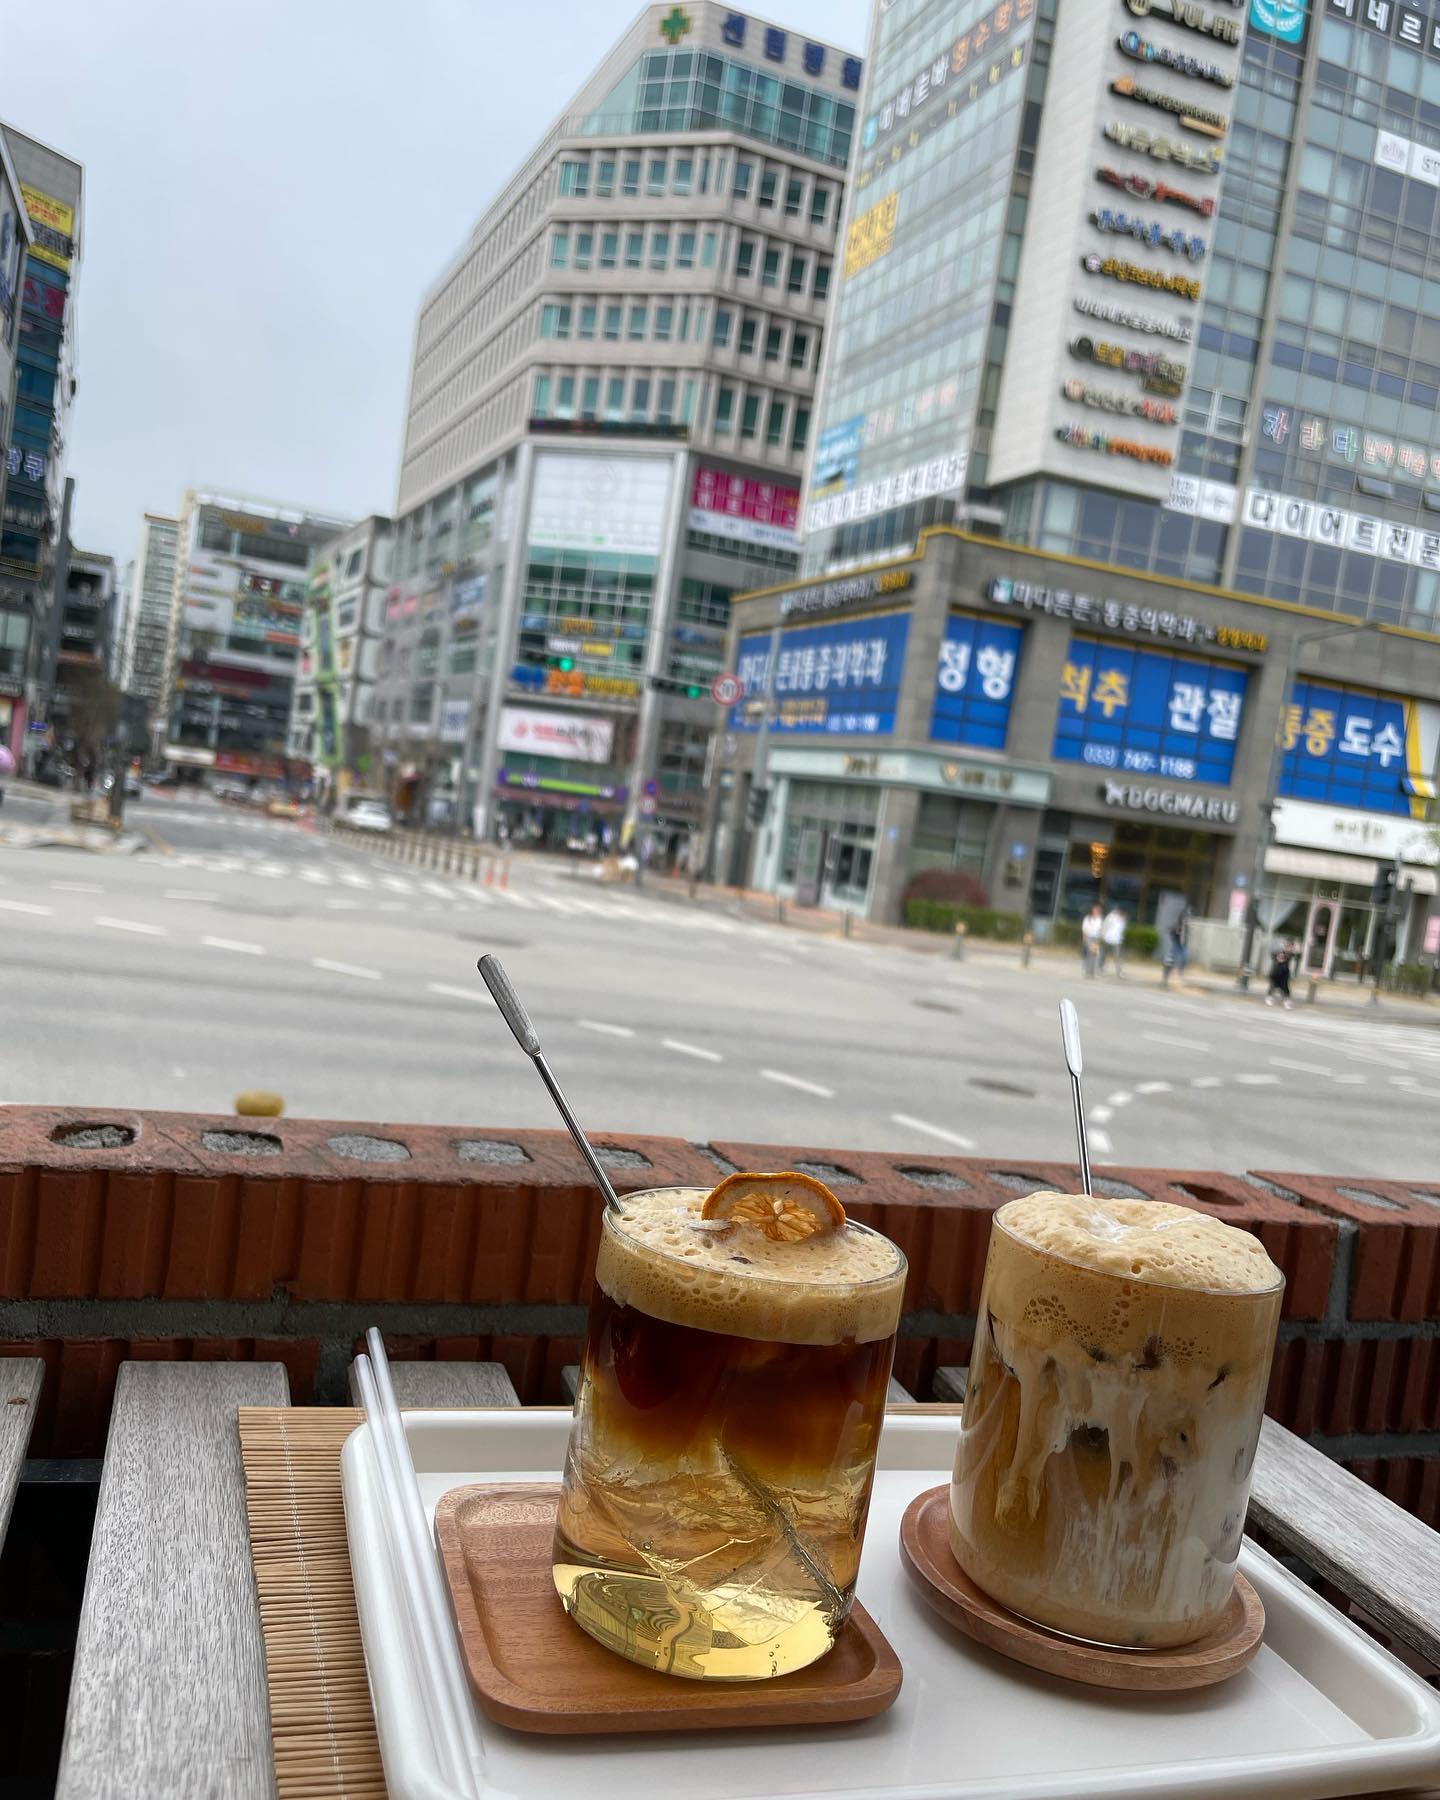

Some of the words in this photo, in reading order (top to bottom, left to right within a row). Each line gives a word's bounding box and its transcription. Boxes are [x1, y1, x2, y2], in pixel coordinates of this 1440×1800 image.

[938, 640, 1015, 699] 정형
[1168, 681, 1242, 741] 관절
[1338, 714, 1403, 767] 도수
[1124, 786, 1239, 824] DOGMARU
